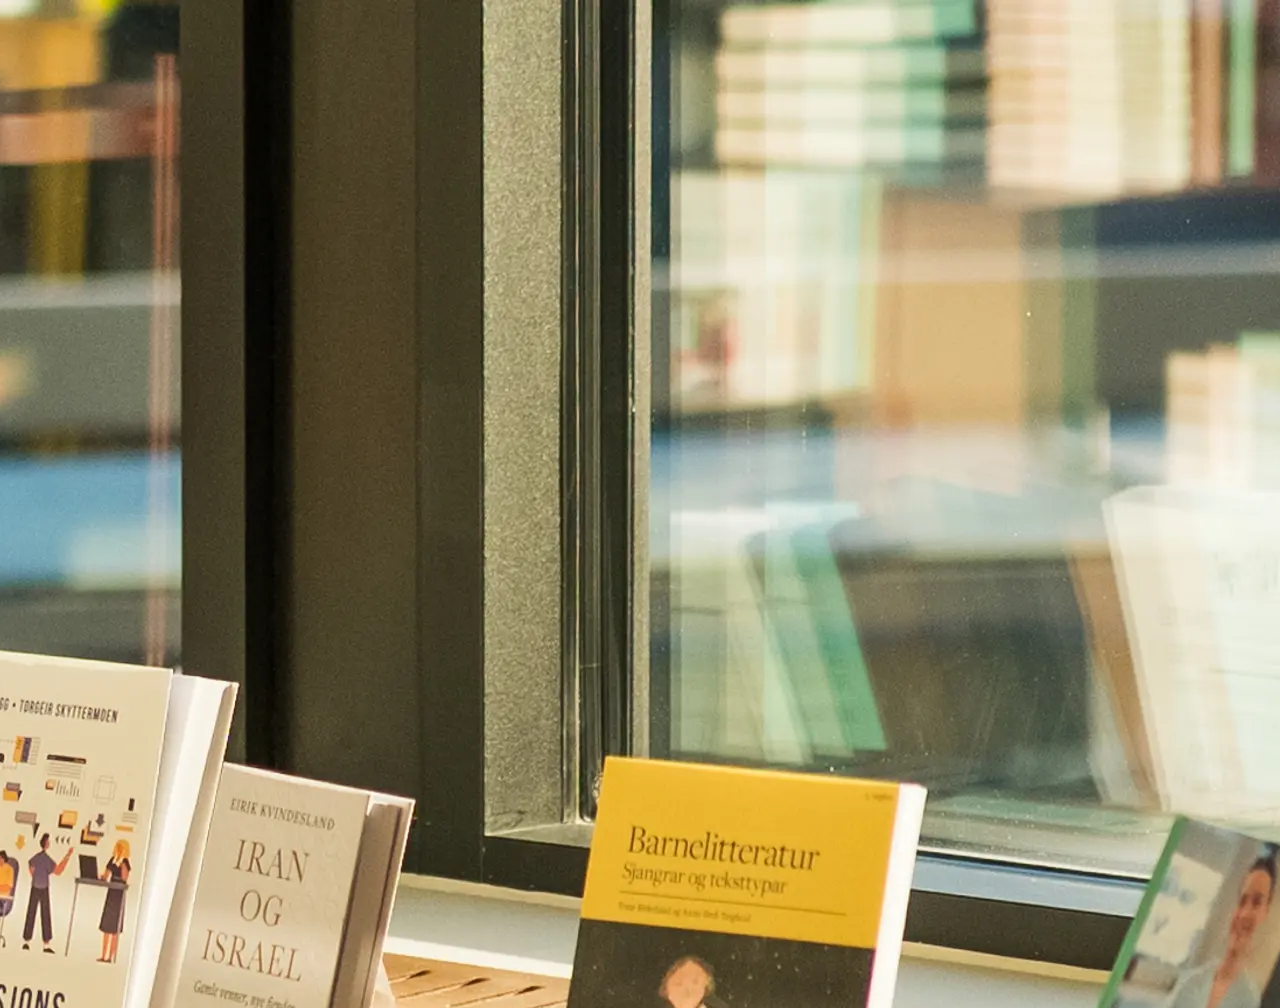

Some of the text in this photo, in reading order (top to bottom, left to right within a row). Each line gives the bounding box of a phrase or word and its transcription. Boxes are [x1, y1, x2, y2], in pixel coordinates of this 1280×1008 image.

[20, 699, 54, 716] TORGEIR
[55, 704, 118, 723] SKYTTERMOEN
[230, 798, 335, 831] EIRIK KVINDESLAND
[233, 839, 310, 883] IRAN
[627, 825, 820, 871] Barnelitteratur
[622, 861, 788, 898] Sjangrar og teksttypar
[240, 889, 283, 927] OG
[201, 929, 303, 982] ISRAEL
